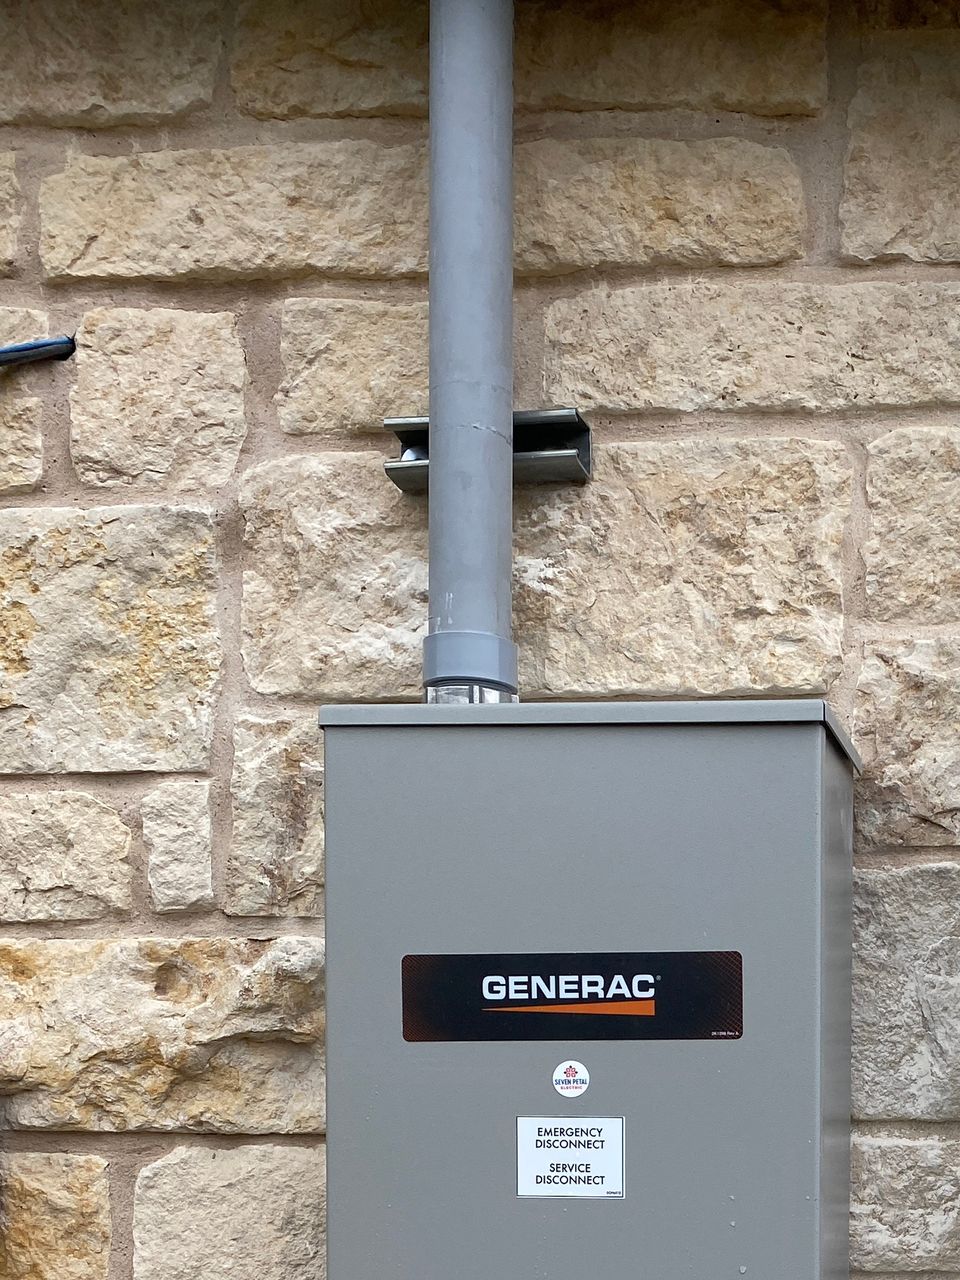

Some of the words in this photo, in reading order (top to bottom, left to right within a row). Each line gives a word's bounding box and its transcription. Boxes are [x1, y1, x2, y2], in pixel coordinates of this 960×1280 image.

[537, 1127, 603, 1137] EMERGENCY
[535, 1139, 605, 1149] DISCONNECT
[549, 1163, 591, 1173] SERVICE
[535, 1175, 605, 1185] DISCONNECT
